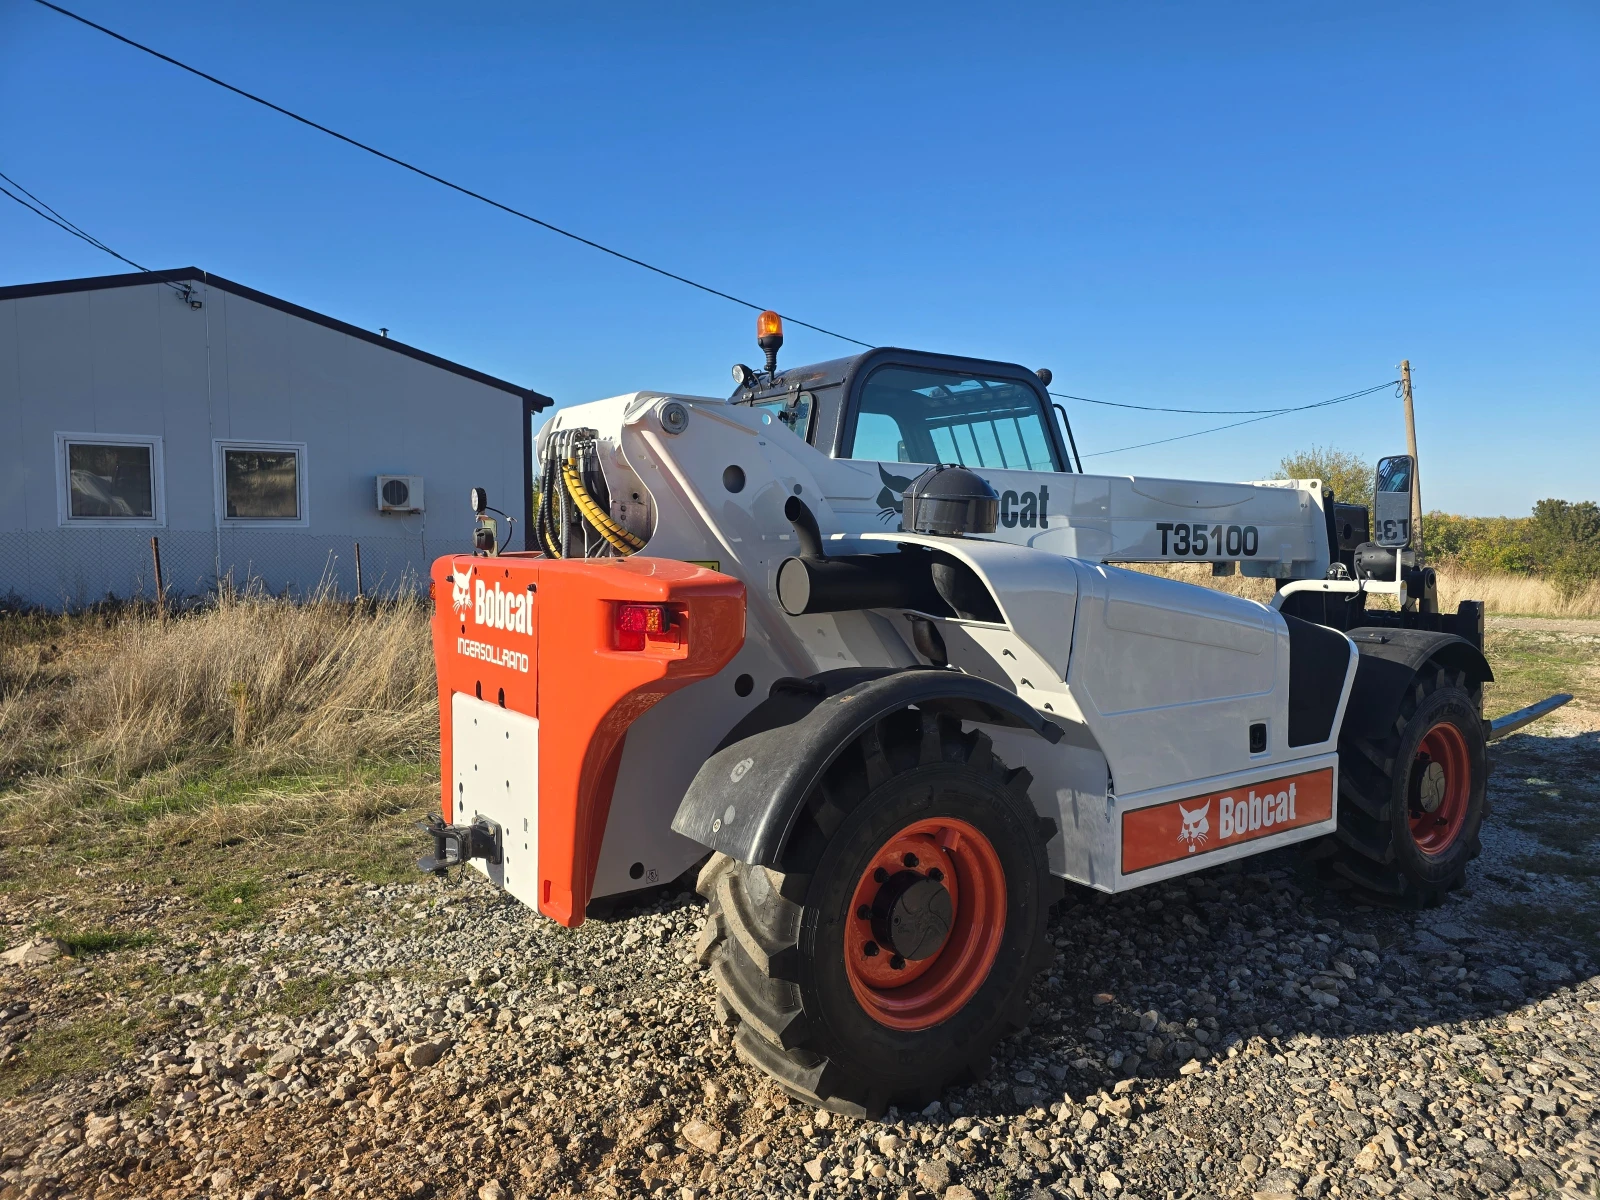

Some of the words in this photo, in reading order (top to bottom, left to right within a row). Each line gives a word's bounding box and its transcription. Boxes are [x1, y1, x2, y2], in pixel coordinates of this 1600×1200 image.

[996, 484, 1050, 530] cat
[1156, 522, 1260, 557] T35100
[475, 579, 534, 636] Bobcat
[1219, 782, 1297, 840] Bobcat
